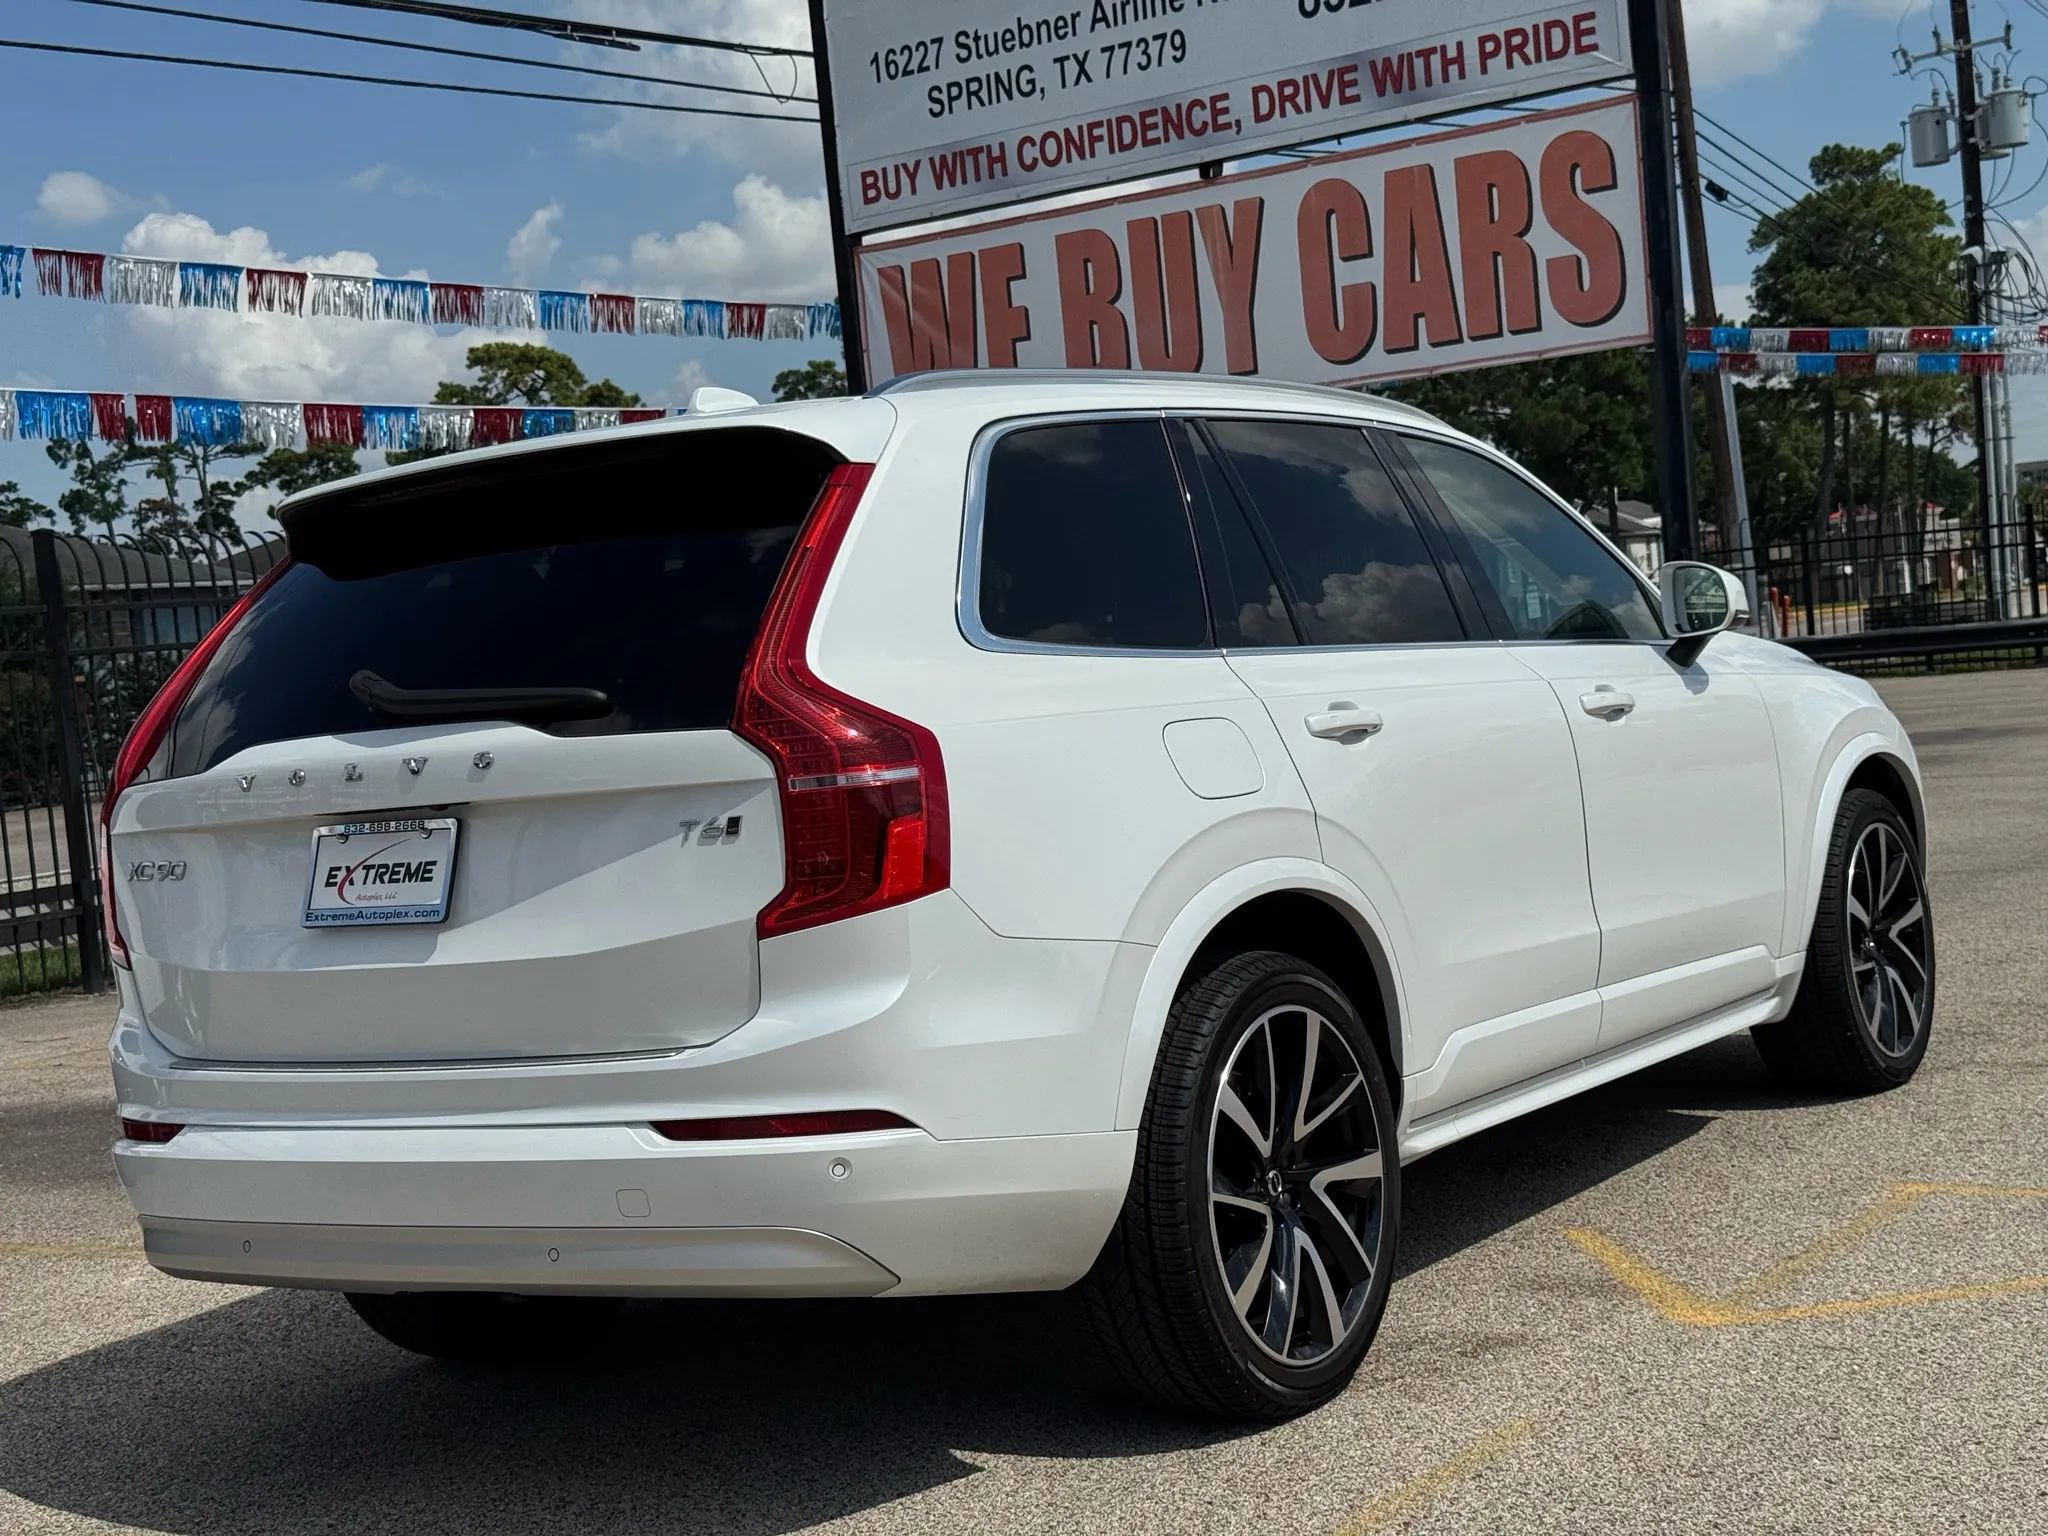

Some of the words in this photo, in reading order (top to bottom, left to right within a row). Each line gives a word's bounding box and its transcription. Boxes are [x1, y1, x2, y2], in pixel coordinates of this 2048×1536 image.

[869, 36, 944, 84] 16227
[954, 10, 1081, 64] Stuebner
[927, 64, 1046, 119] SPRING,
[1053, 50, 1094, 89] TX
[1100, 29, 1187, 80] 77379
[860, 159, 921, 206] BUY
[929, 141, 1008, 191] WITH
[1016, 92, 1243, 173] CONFIDENCE,
[1252, 63, 1361, 124] DRIVE
[1368, 40, 1466, 98] WITH
[1477, 11, 1600, 76] PRIDE
[876, 241, 1031, 375] WE
[1054, 195, 1265, 376] BUY
[1297, 130, 1627, 366] CARS
[235, 751, 495, 793] VOLVO
[679, 816, 725, 842] T6
[127, 860, 188, 883] XC90
[324, 860, 438, 889] EXTREME
[304, 908, 440, 923] ExtremeAutoplex.com
